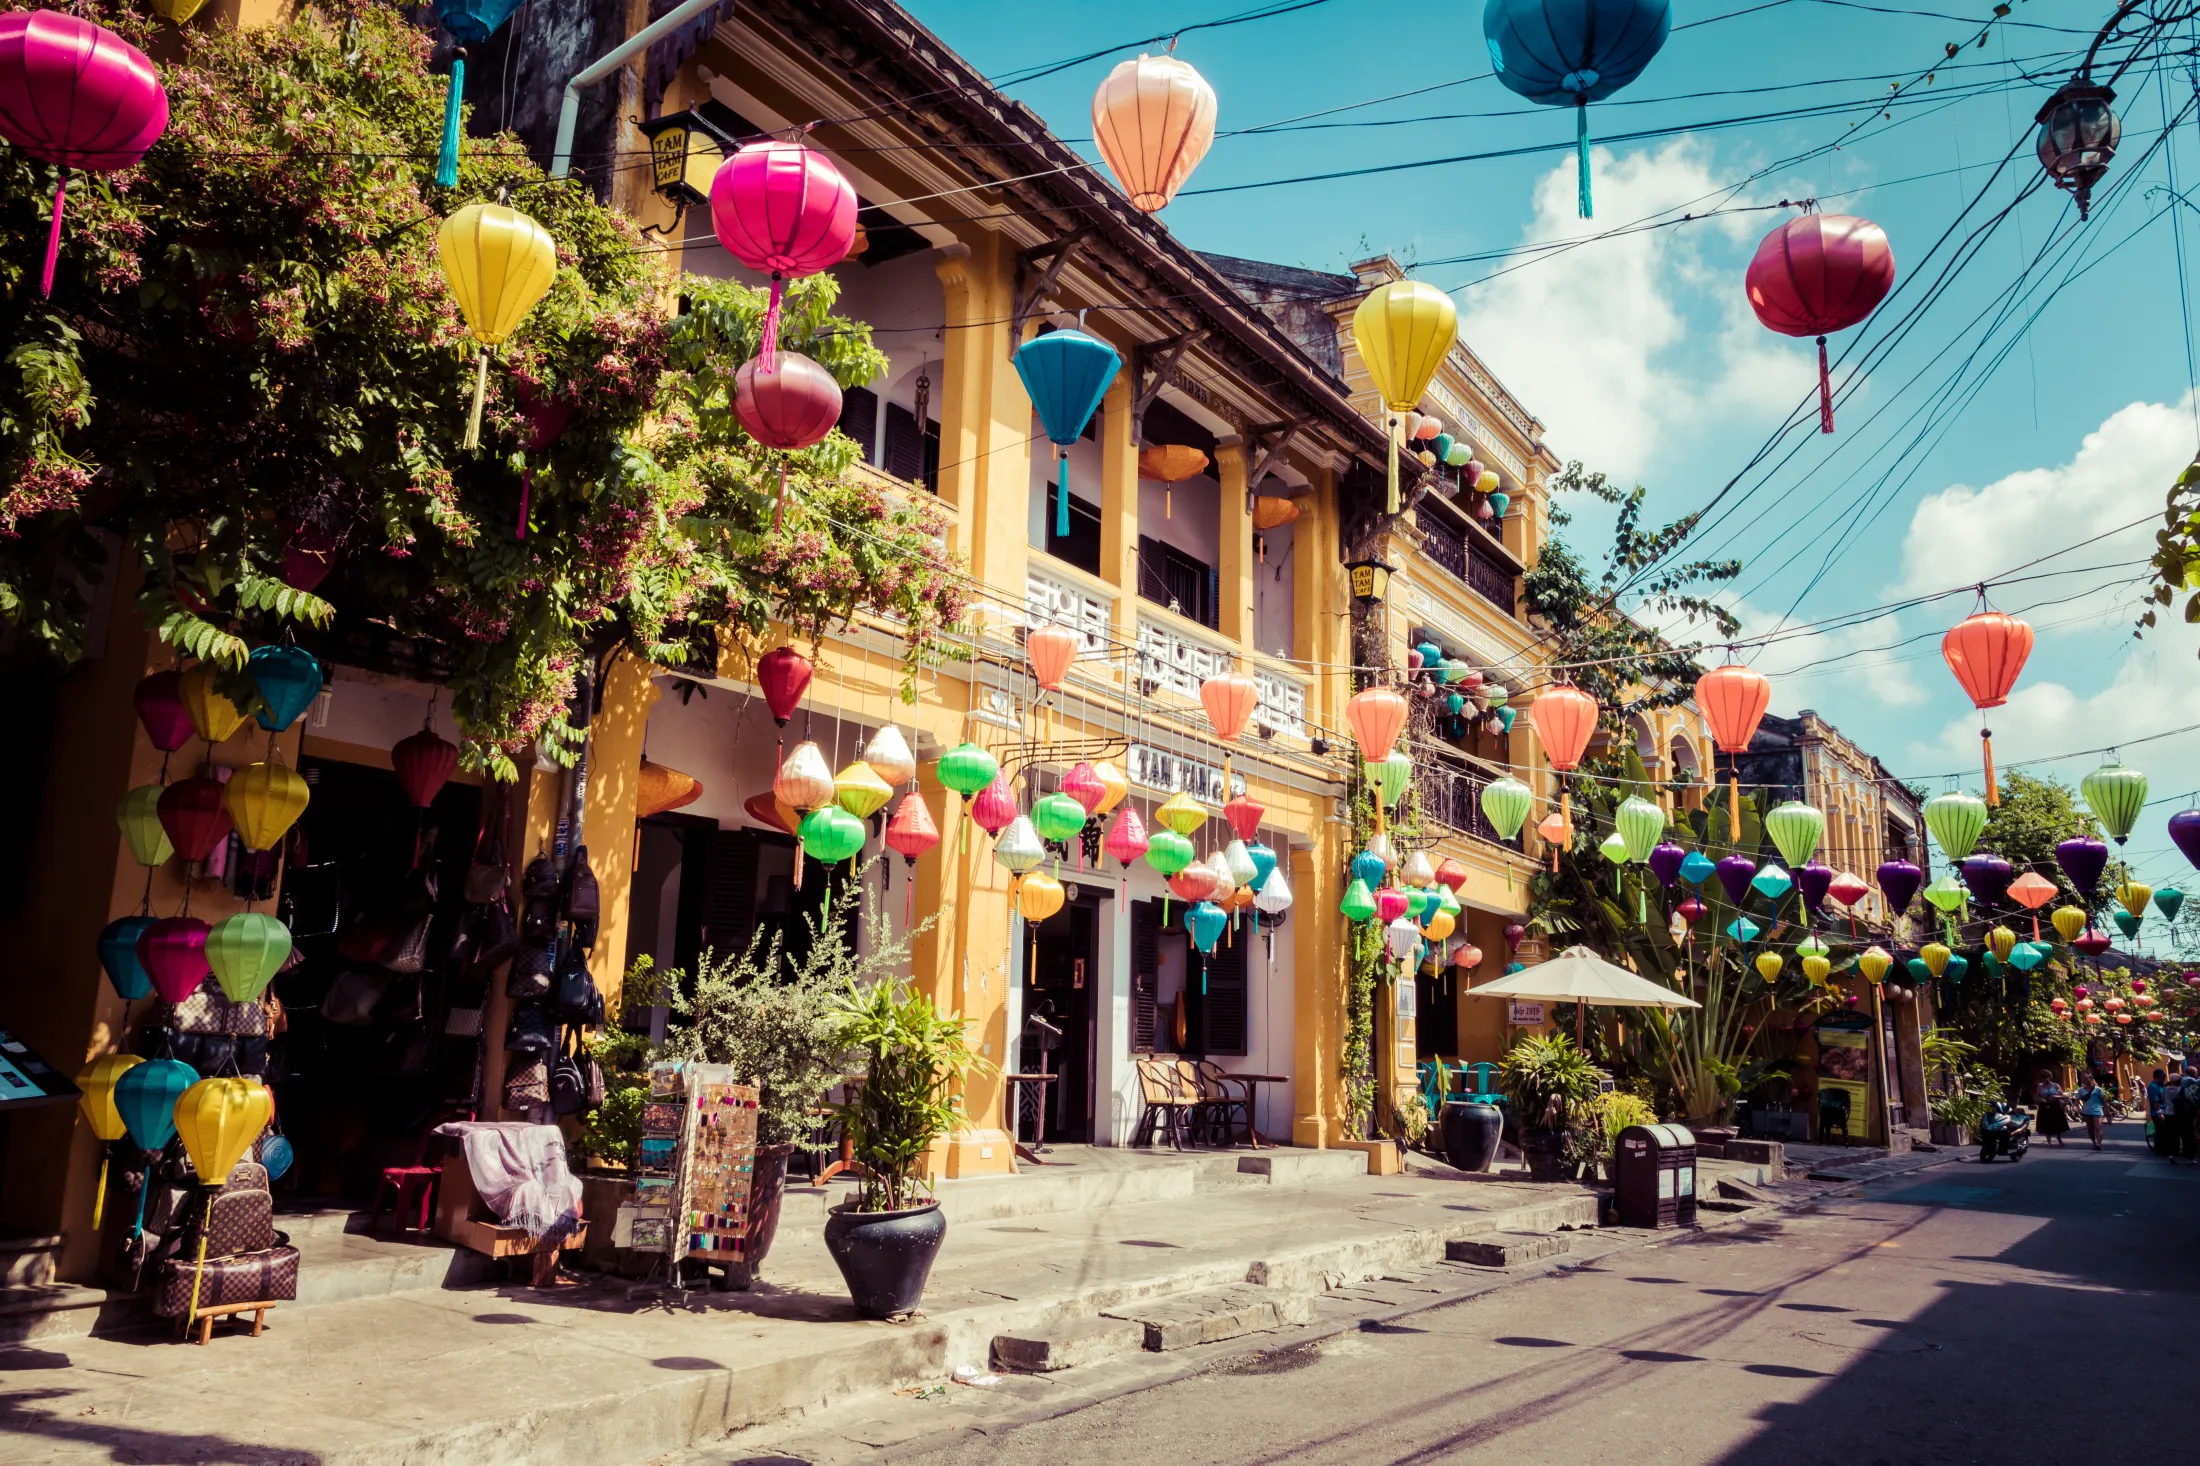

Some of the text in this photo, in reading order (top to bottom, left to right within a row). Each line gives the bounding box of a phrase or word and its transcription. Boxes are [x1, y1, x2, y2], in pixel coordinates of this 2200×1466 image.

[656, 134, 682, 153] TAM
[656, 152, 681, 169] TAM
[657, 167, 679, 181] CAFE
[1353, 569, 1370, 579] TAM
[1354, 579, 1370, 587] TAM
[1138, 749, 1174, 789] TAM
